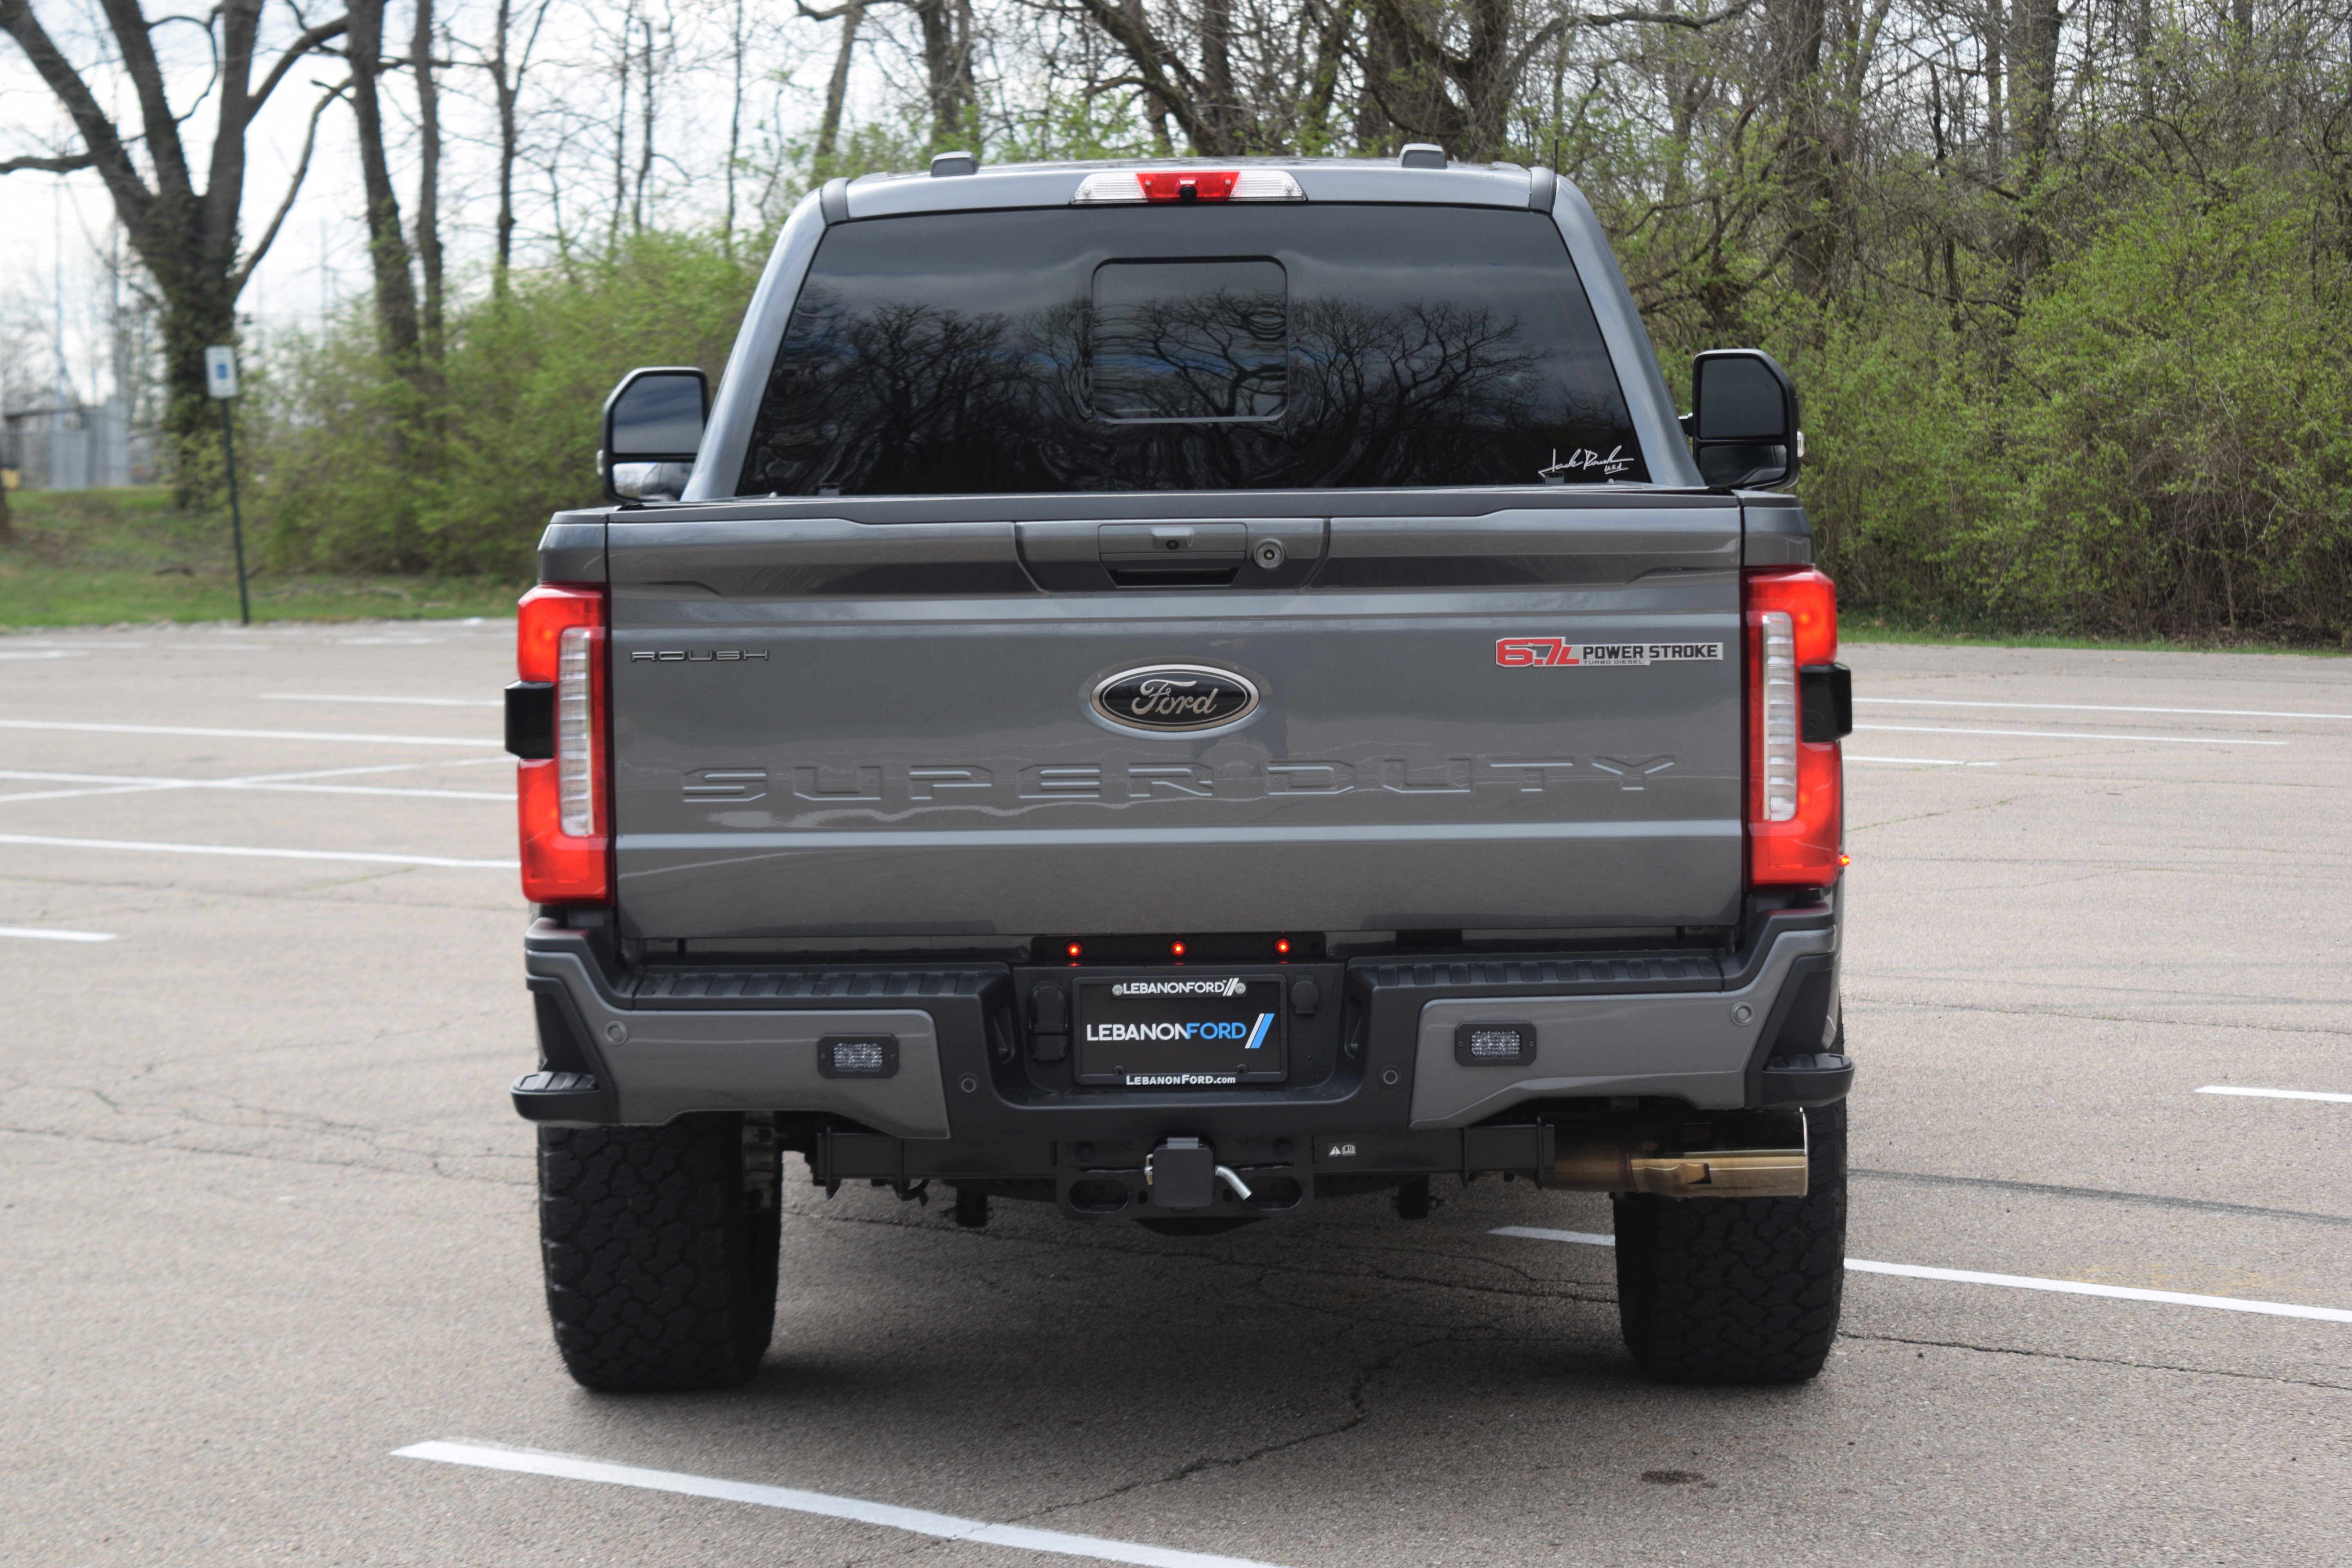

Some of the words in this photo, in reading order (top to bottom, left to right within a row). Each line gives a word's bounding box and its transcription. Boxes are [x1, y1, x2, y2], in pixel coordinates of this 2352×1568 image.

[1604, 462, 1628, 472] USA
[631, 650, 768, 662] ROUSH
[1496, 639, 1579, 666] 6.7L
[1583, 646, 1644, 659] POWER
[1649, 644, 1717, 659] STROKE
[1131, 679, 1218, 715] Ford
[683, 762, 1213, 802] SUPER
[1266, 755, 1675, 795] DUTY
